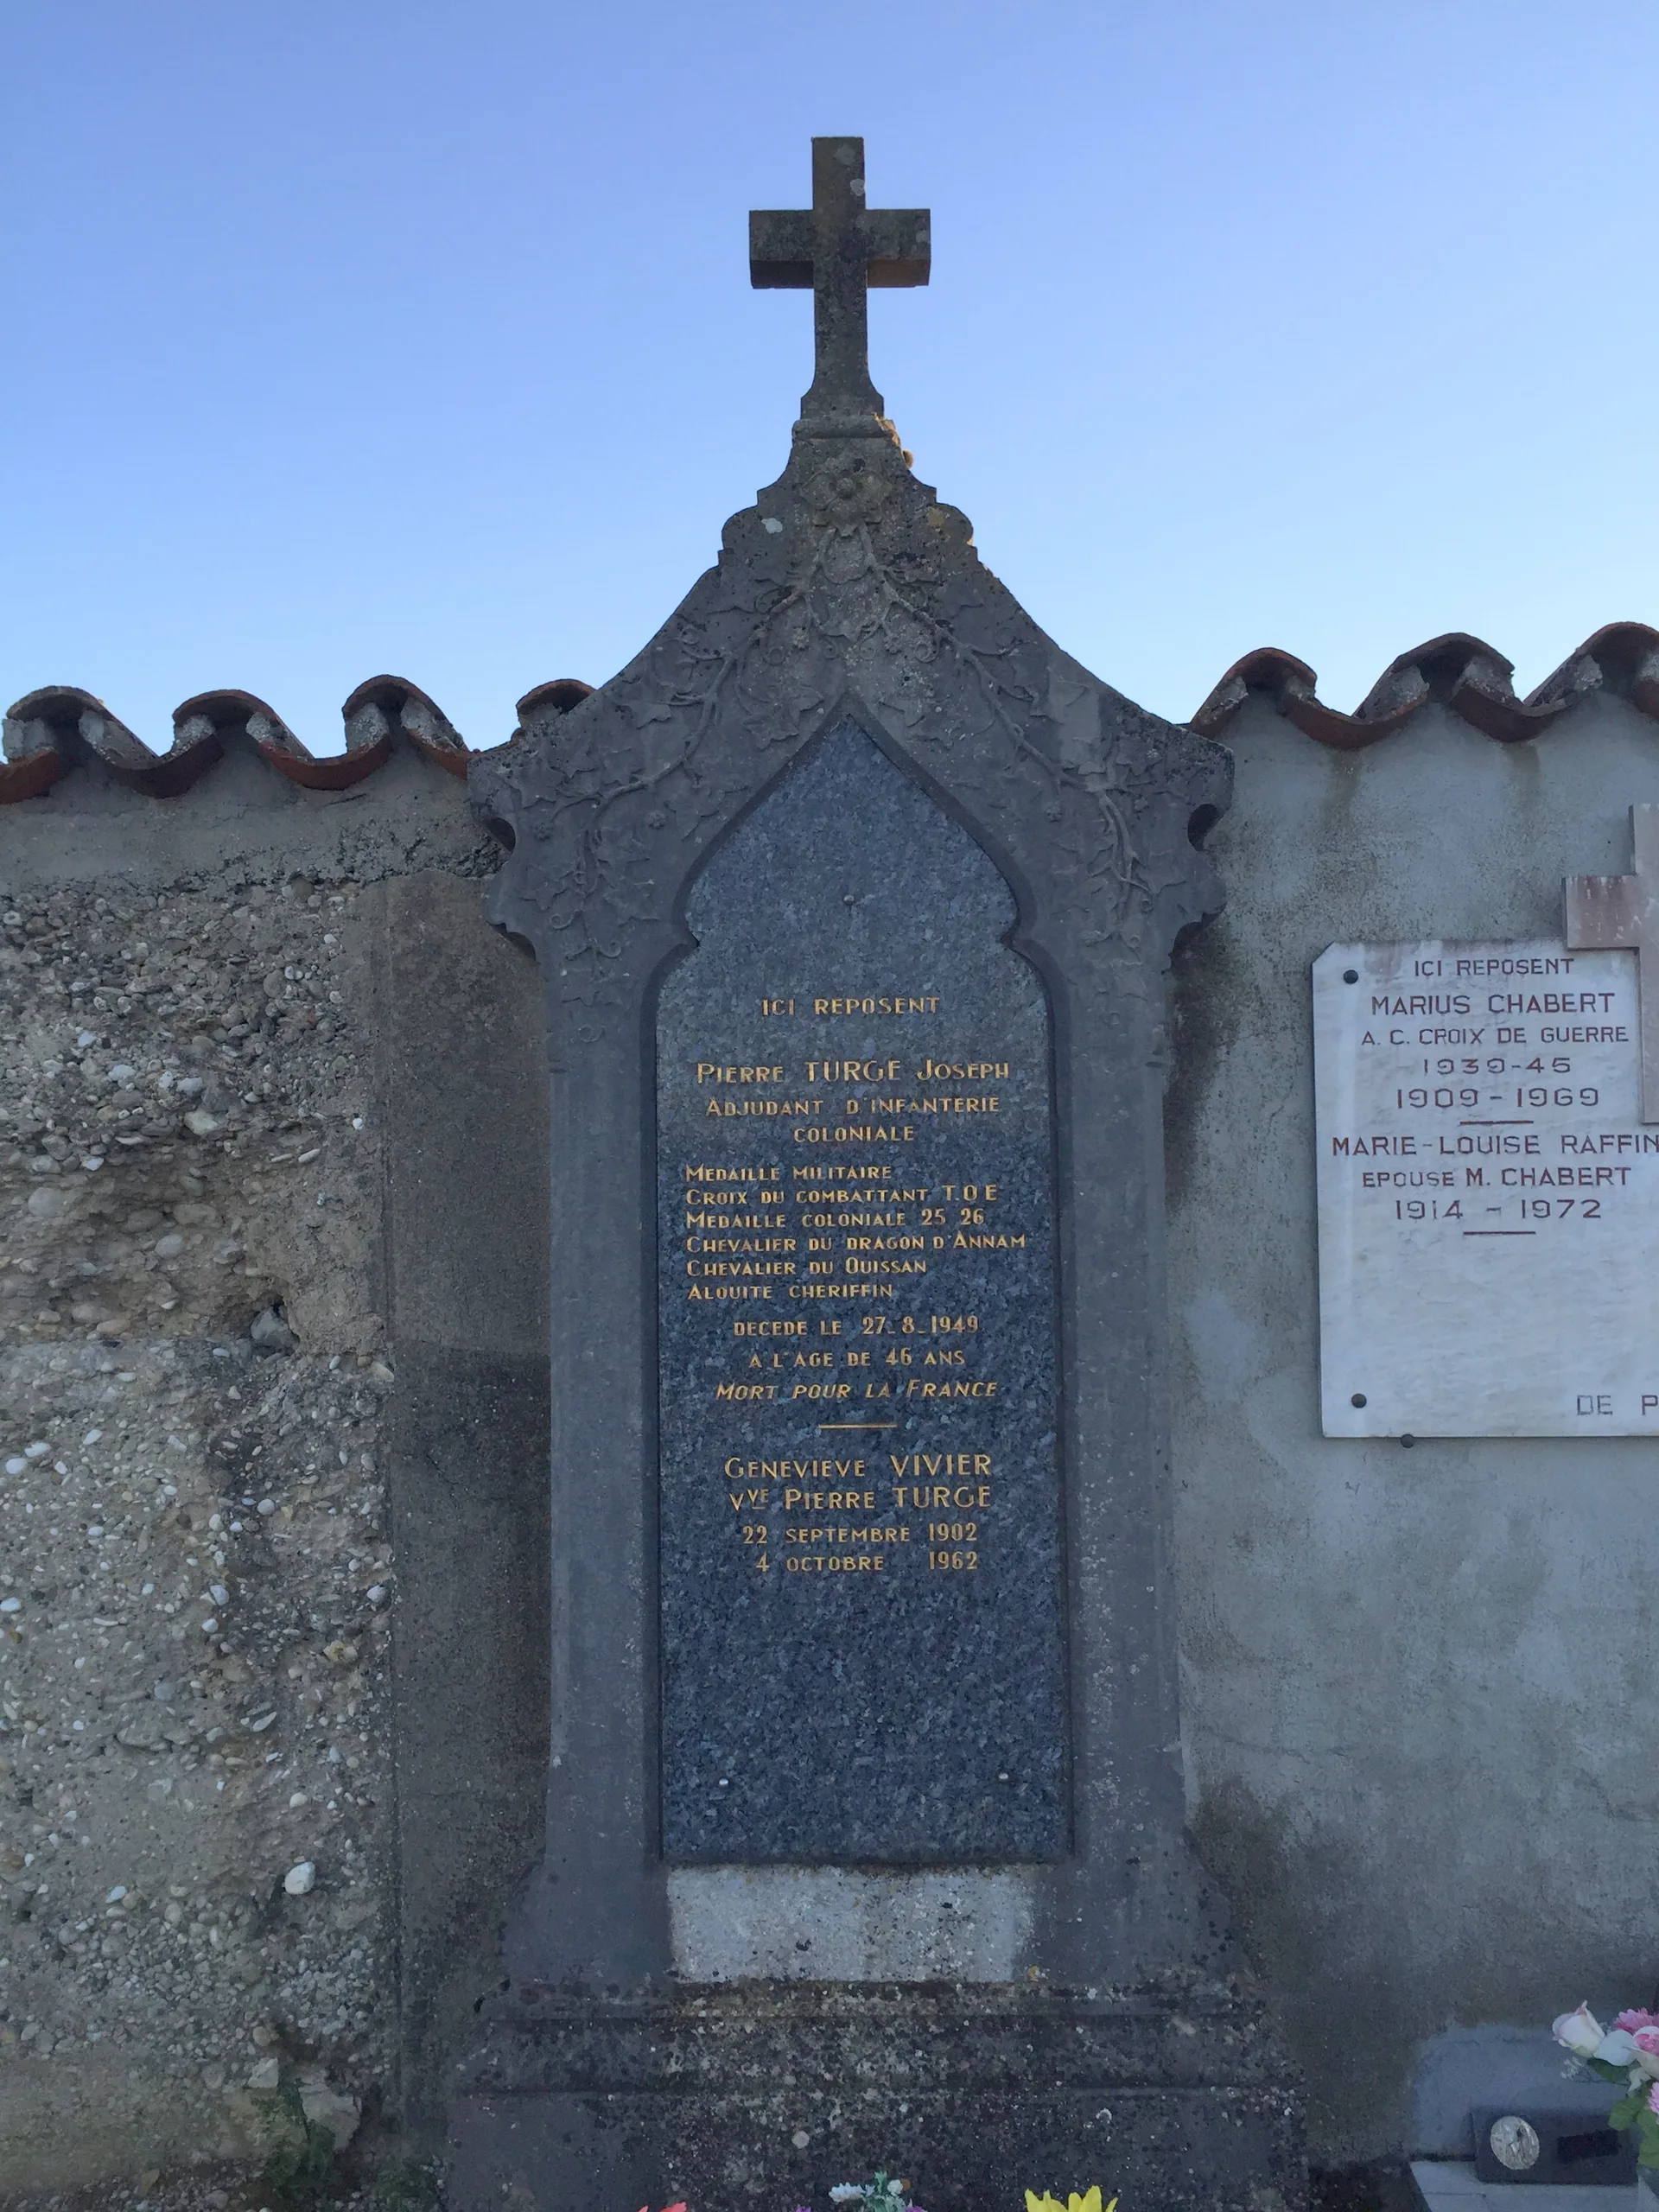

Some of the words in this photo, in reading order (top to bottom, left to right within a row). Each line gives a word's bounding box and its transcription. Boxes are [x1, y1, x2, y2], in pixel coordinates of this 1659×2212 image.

[1414, 959, 1442, 977] ICI
[1457, 957, 1574, 976] REPOSENT
[761, 998, 795, 1016] ICI
[815, 996, 940, 1015] REPOSENT
[1371, 995, 1471, 1016] MARIUS
[1488, 992, 1615, 1014] CHABERT
[1419, 1027, 1484, 1046] CROIX
[1497, 1027, 1527, 1044] DE
[1541, 1026, 1629, 1043] GUERRE
[696, 1062, 785, 1084] PIERRE
[804, 1059, 901, 1082] TURGE
[916, 1058, 1009, 1080] JOSEPH
[1423, 1057, 1572, 1076] 1939-45
[705, 1098, 823, 1116] ADJUDANT
[846, 1096, 1000, 1115] D'INFANTERIE
[1397, 1088, 1478, 1109] 1909
[1517, 1087, 1599, 1108] 1969
[793, 1125, 915, 1143] COLONIALE
[685, 1163, 780, 1182] MEDAILLE
[792, 1166, 892, 1180] MILITAIRE
[1362, 1171, 1454, 1189] EPOUSE
[1465, 1167, 1491, 1187] M.
[1501, 1166, 1631, 1187] CHABERT
[686, 1189, 748, 1205] CROIX
[760, 1190, 785, 1205] DU
[796, 1188, 929, 1204] COMBATTANT
[686, 1211, 785, 1229] MEDAILLE
[802, 1212, 906, 1228] COLONIALE
[921, 1208, 946, 1225] 25
[960, 1208, 984, 1225] 26
[1395, 1199, 1463, 1221] 1914
[1521, 1198, 1602, 1220] 1972
[686, 1236, 797, 1253] CHEVALIER
[808, 1237, 832, 1251] DU
[847, 1236, 925, 1250] DRAGON
[686, 1260, 797, 1276] CHEVALIER
[809, 1261, 834, 1274] DU
[845, 1256, 927, 1274] OUISSAN
[687, 1282, 772, 1300] ALOUITE
[789, 1284, 893, 1298] CHERIFFIN
[734, 1320, 808, 1337] DECEDE
[820, 1320, 842, 1336] LE
[748, 1352, 762, 1369] A
[773, 1351, 834, 1368] L'AGE
[847, 1351, 871, 1367] DE
[885, 1347, 912, 1366] 46
[924, 1351, 966, 1366] ANS
[715, 1382, 779, 1401] MORT
[791, 1383, 851, 1399] POUR
[865, 1382, 892, 1398] LA
[906, 1379, 998, 1399] FRANCE
[1577, 1395, 1613, 1415] DE
[724, 1457, 865, 1478] GENEVIEVE
[890, 1453, 991, 1478] VIVIER
[785, 1488, 875, 1510] PIERRE
[892, 1485, 991, 1508] TURGE
[742, 1525, 767, 1544] 22
[785, 1527, 910, 1543] SEPTEMBRE
[929, 1522, 977, 1541] 1902
[756, 1552, 769, 1572] 4
[786, 1555, 884, 1572] OCTOBRE
[929, 1551, 978, 1570] 1962
